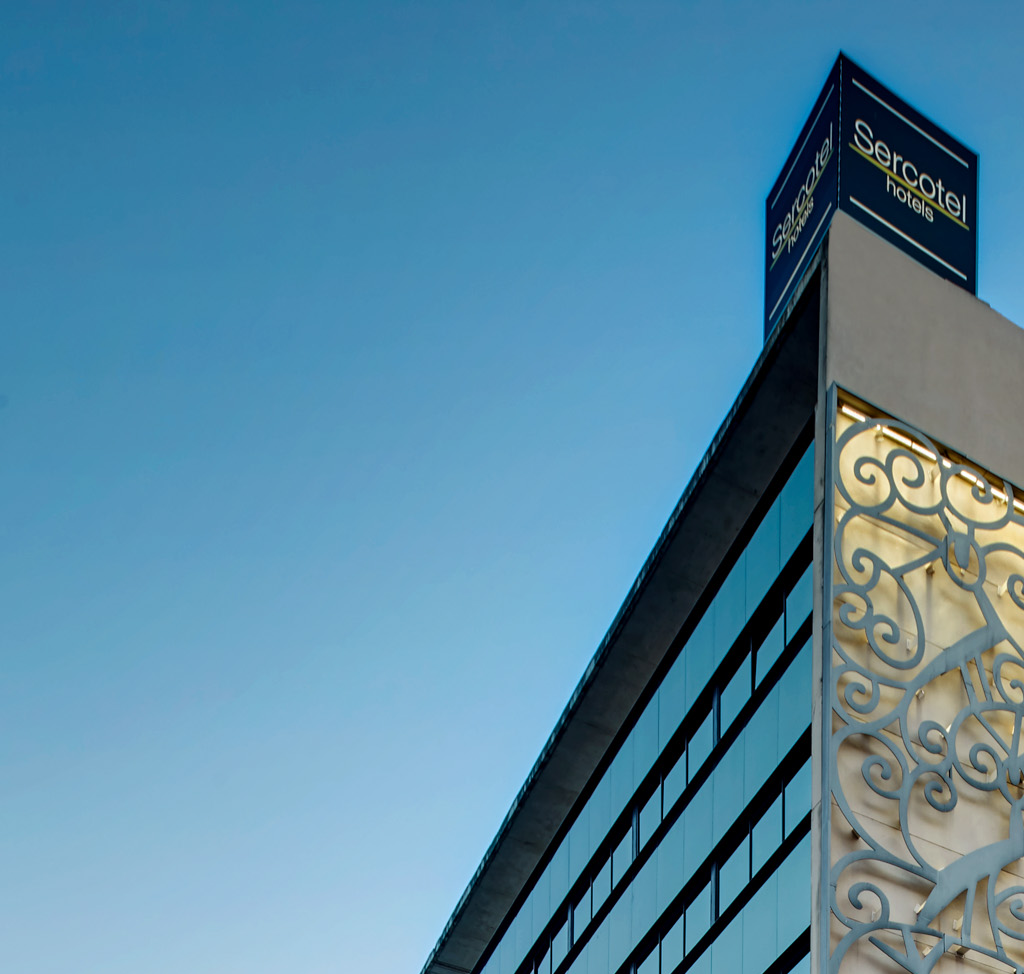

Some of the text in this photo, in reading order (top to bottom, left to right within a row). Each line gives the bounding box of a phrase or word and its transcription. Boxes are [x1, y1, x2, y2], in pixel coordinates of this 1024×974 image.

[772, 121, 833, 260] Sercotel
[854, 119, 966, 223] Sercotel
[887, 174, 934, 222] hotels
[787, 197, 814, 254] hotels
